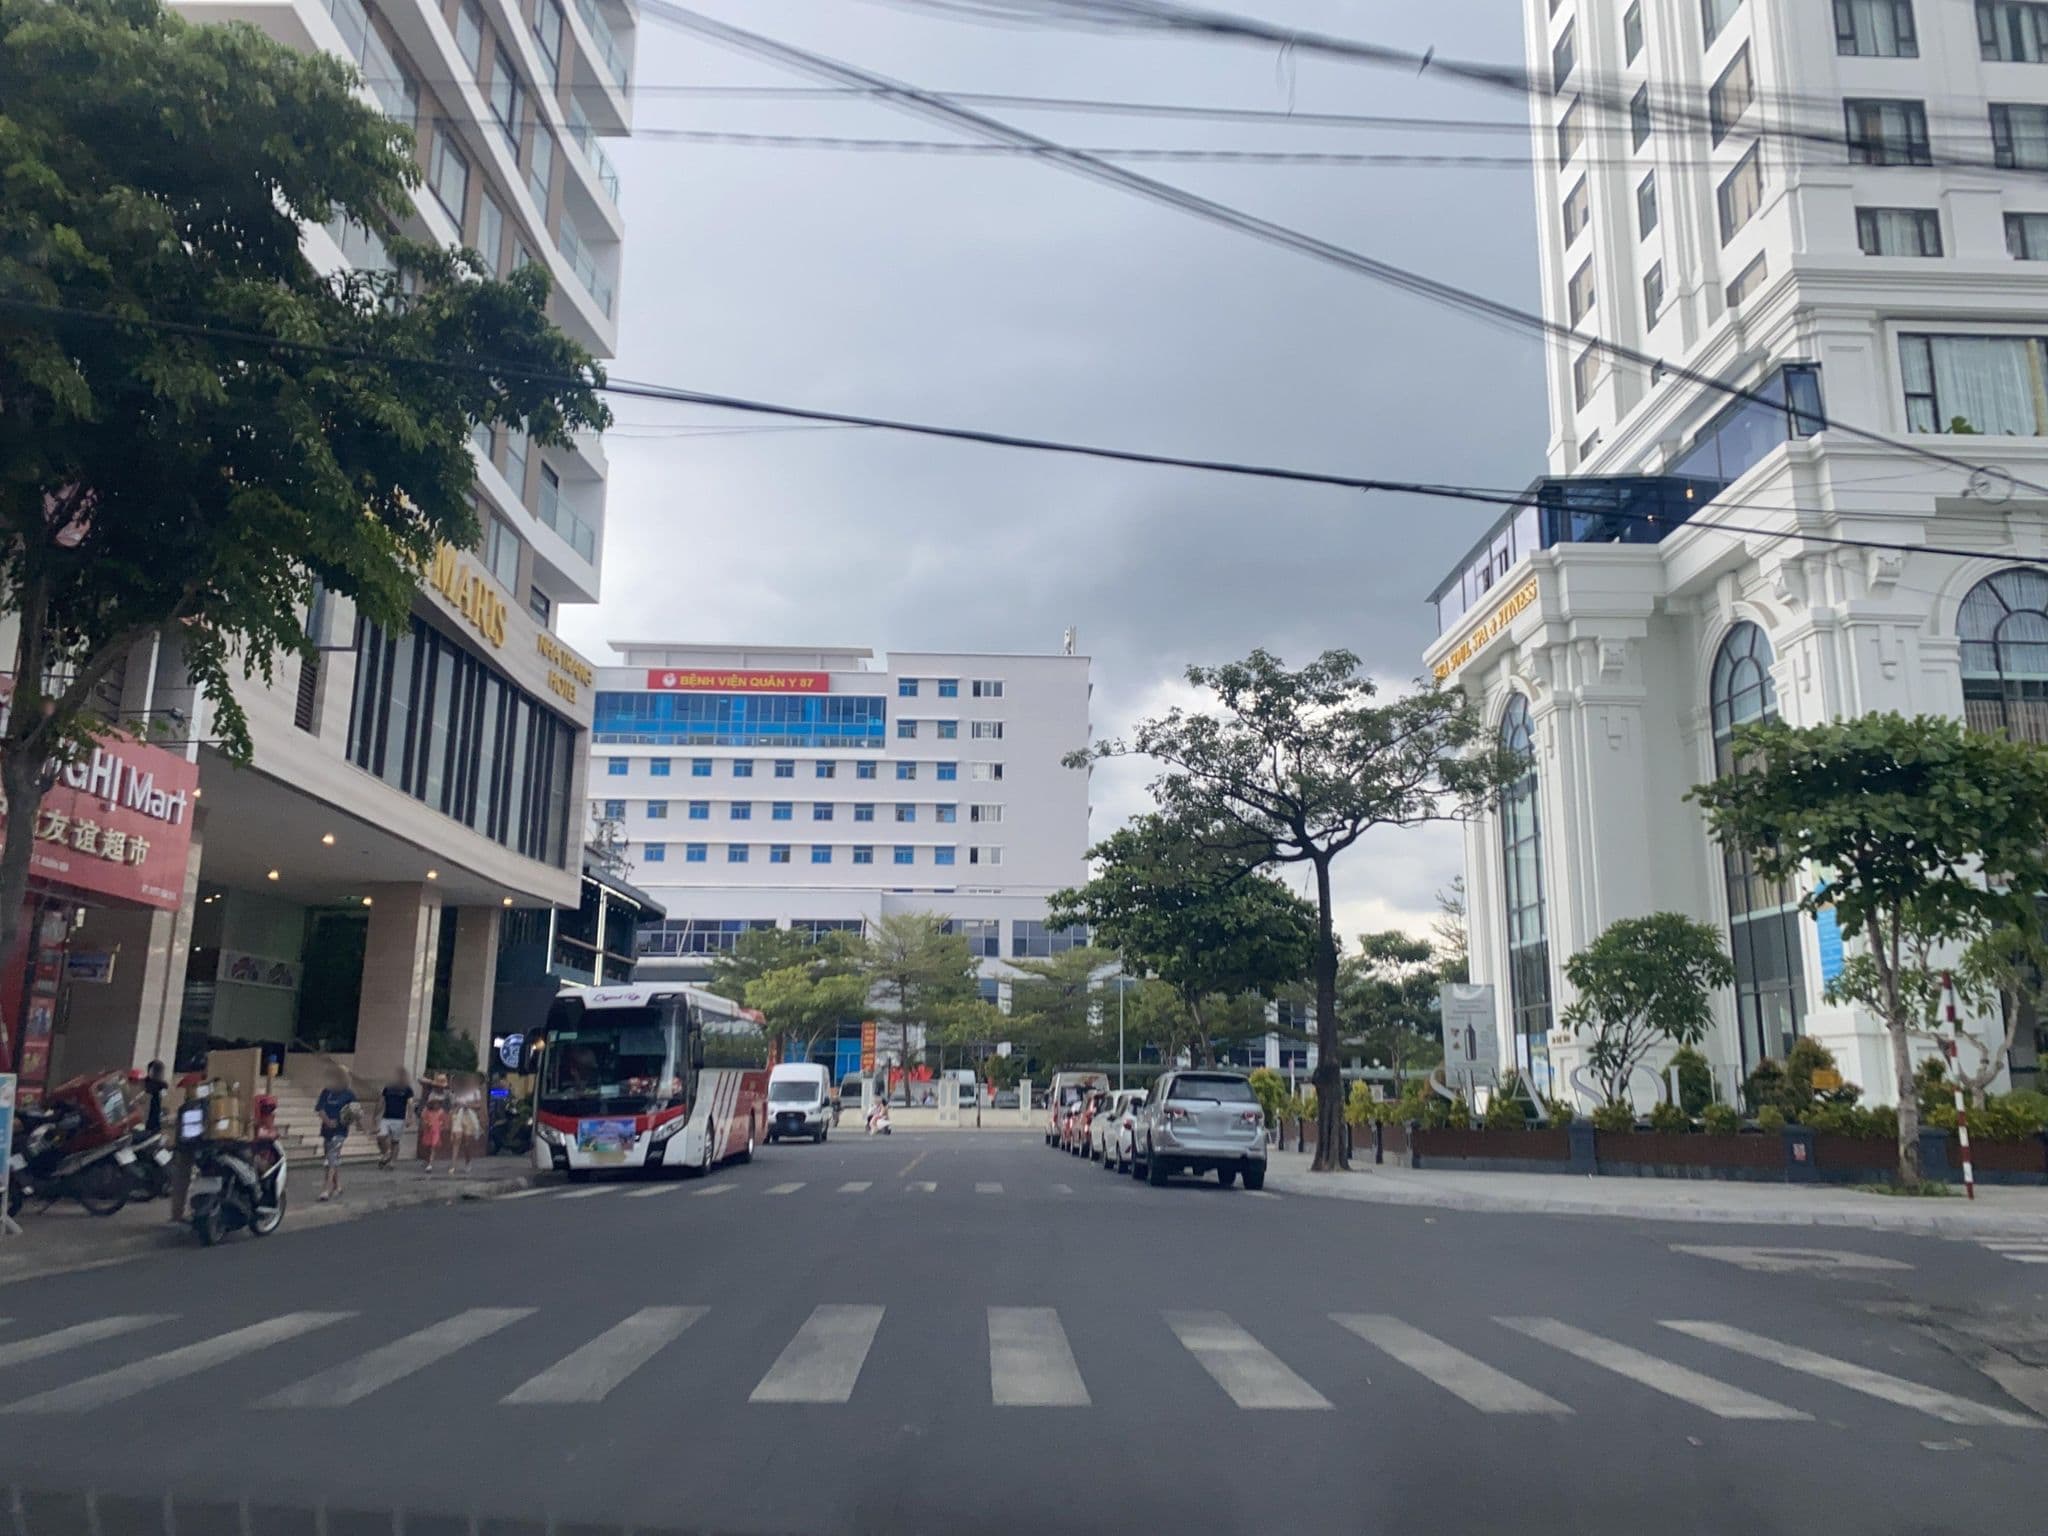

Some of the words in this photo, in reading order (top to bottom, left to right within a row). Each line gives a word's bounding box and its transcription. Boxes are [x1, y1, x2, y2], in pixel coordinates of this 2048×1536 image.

[1472, 625, 1489, 652] SPA
[547, 669, 577, 705] HOTEL
[679, 672, 715, 689] BỆNH
[717, 672, 747, 689] VIỆN
[749, 674, 785, 689] QUÂN
[787, 676, 798, 689] Y
[127, 765, 188, 825] Mart
[35, 808, 151, 866] 友谊超市
